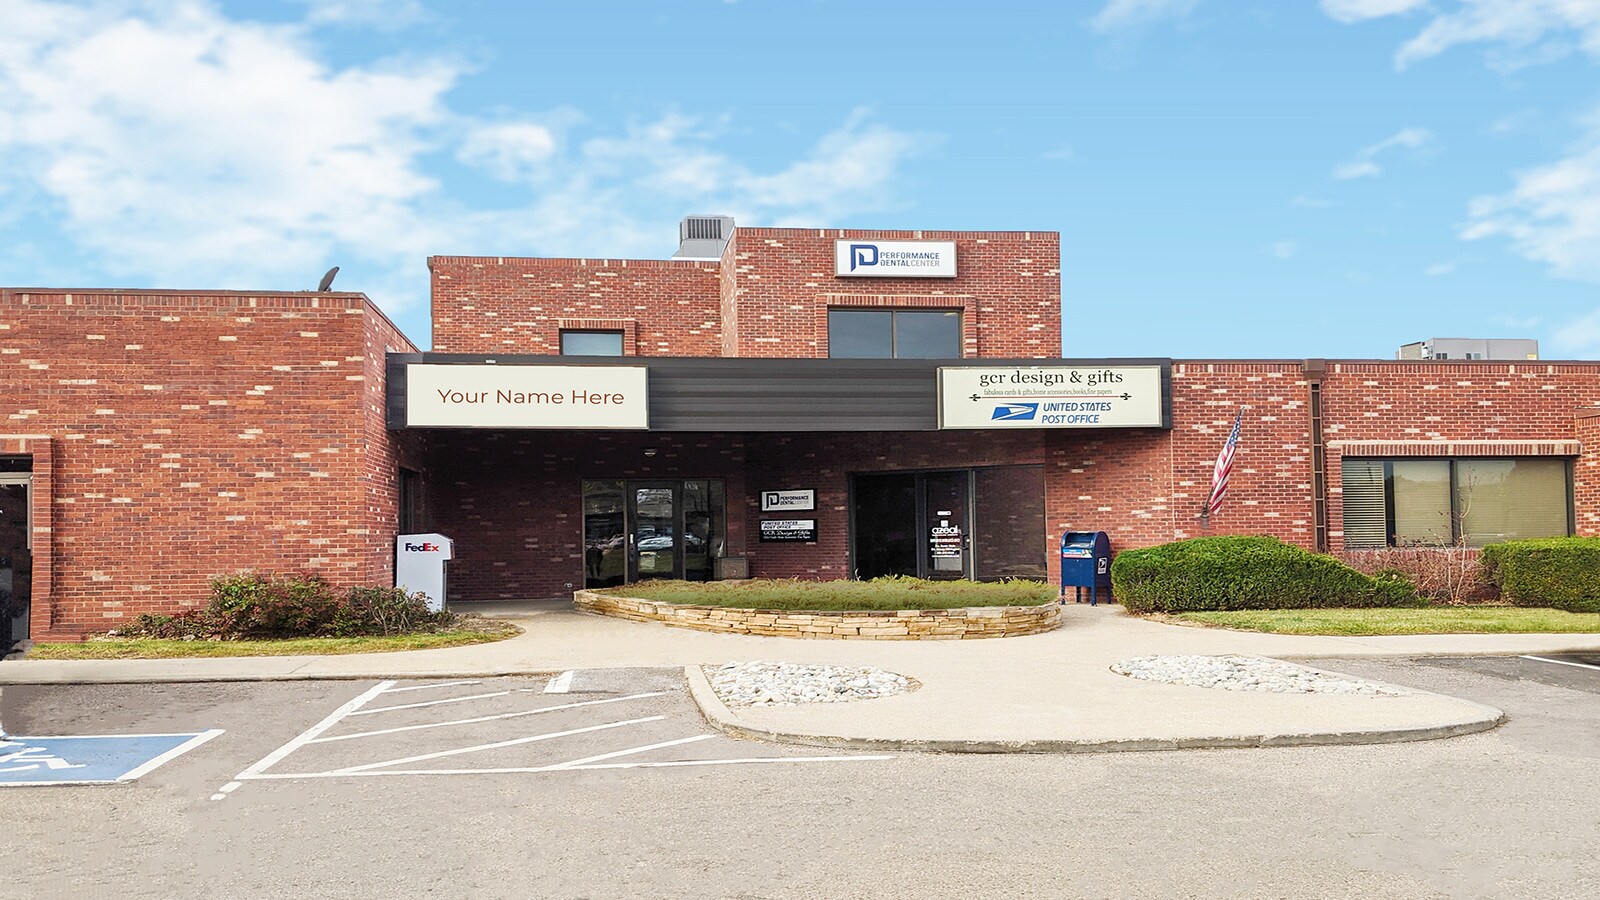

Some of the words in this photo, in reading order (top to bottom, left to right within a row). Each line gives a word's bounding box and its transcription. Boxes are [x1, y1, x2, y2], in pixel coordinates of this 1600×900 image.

[880, 252, 940, 260] PERFORMANCE
[980, 374, 1006, 387] gcr
[1010, 370, 1064, 387] design
[1069, 370, 1083, 384] &
[1087, 370, 1123, 387] gifts
[437, 389, 489, 404] Your
[496, 389, 564, 404] Name
[572, 390, 625, 405] Here
[1043, 402, 1079, 412] UNITED
[1079, 402, 1112, 412] STATES
[1041, 414, 1066, 424] POST
[1066, 414, 1100, 424] OFFICE
[932, 524, 958, 533] azeal
[405, 542, 440, 552] FedEx
